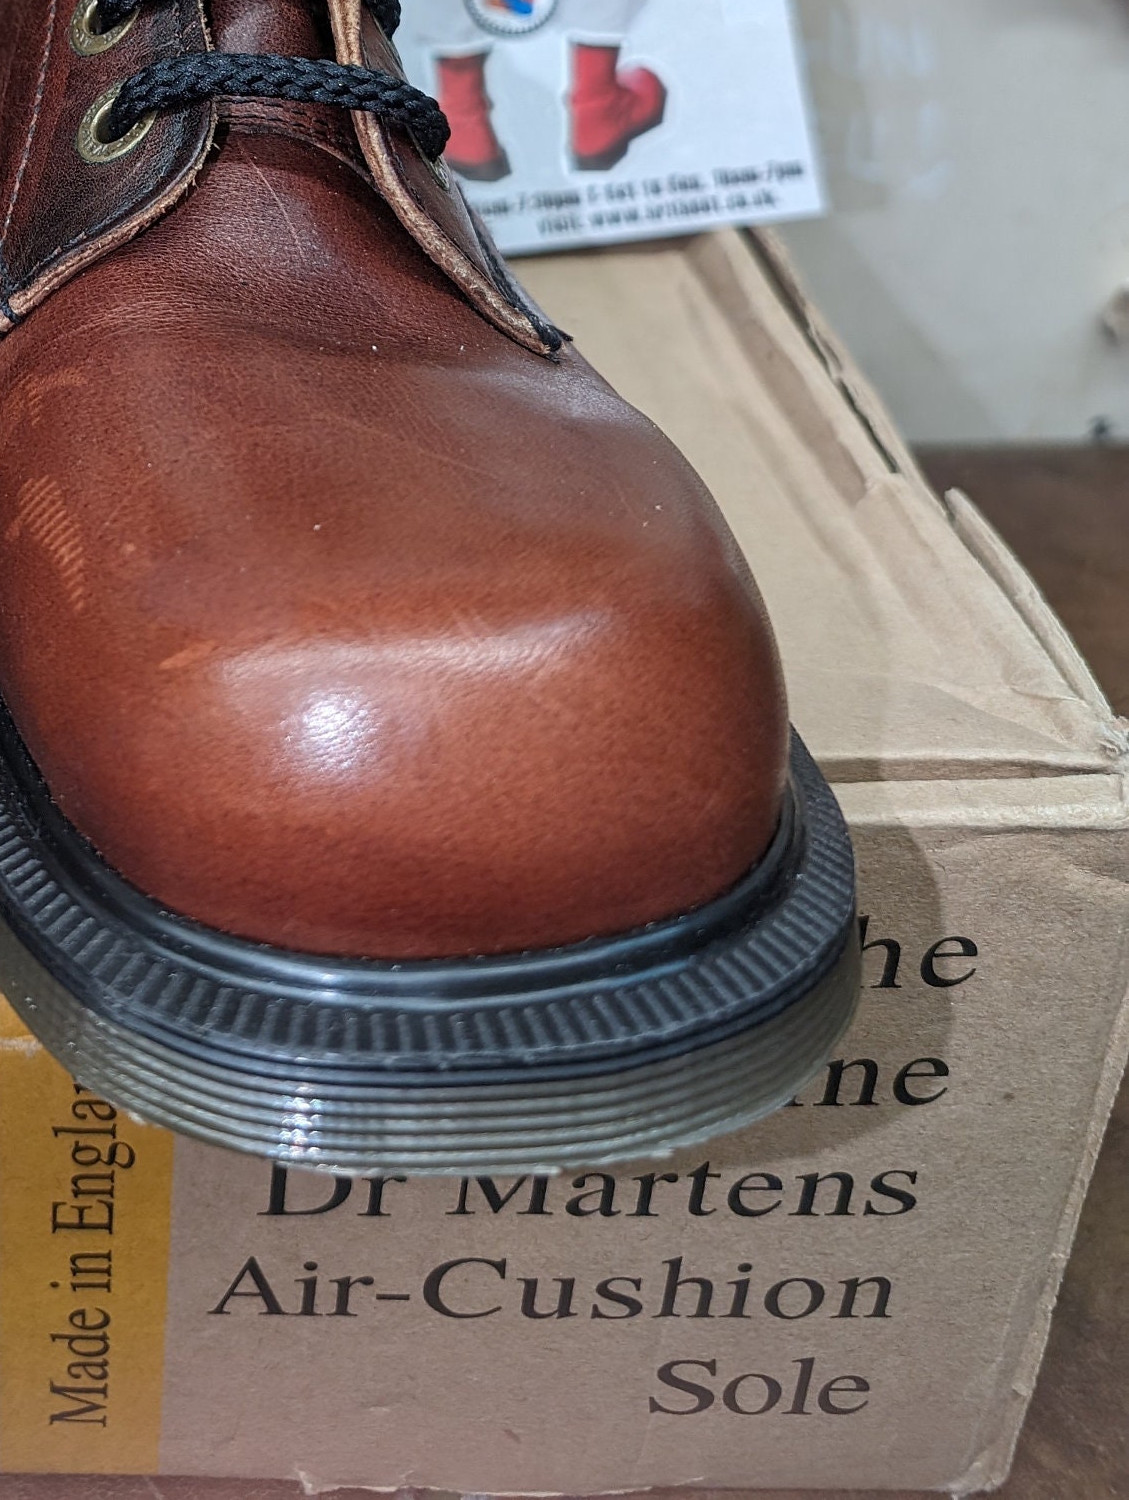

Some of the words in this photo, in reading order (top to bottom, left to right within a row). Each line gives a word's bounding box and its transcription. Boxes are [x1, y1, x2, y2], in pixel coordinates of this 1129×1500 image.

[52, 1082, 136, 1235] Engla
[445, 1160, 919, 1218] Martens
[50, 1249, 113, 1293] in
[207, 1255, 894, 1321] Air-Cushion
[49, 1306, 111, 1428] Made
[648, 1357, 873, 1417] Sole
